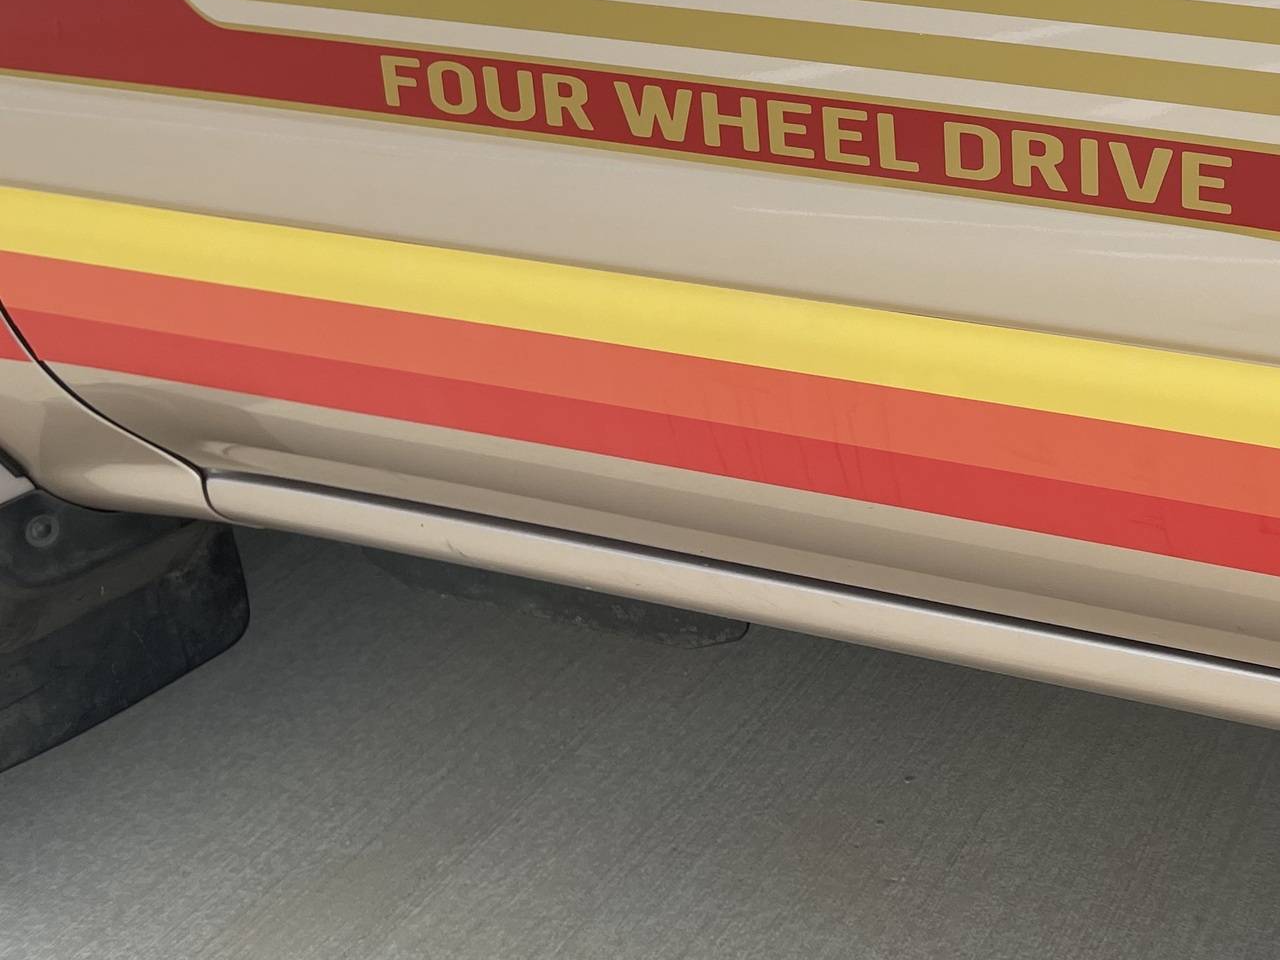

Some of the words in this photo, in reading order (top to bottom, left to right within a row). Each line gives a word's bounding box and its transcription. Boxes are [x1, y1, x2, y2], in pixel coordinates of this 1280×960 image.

[380, 54, 594, 131] FOUR
[613, 80, 920, 173] WHEEL
[943, 121, 1233, 215] DRIVE
